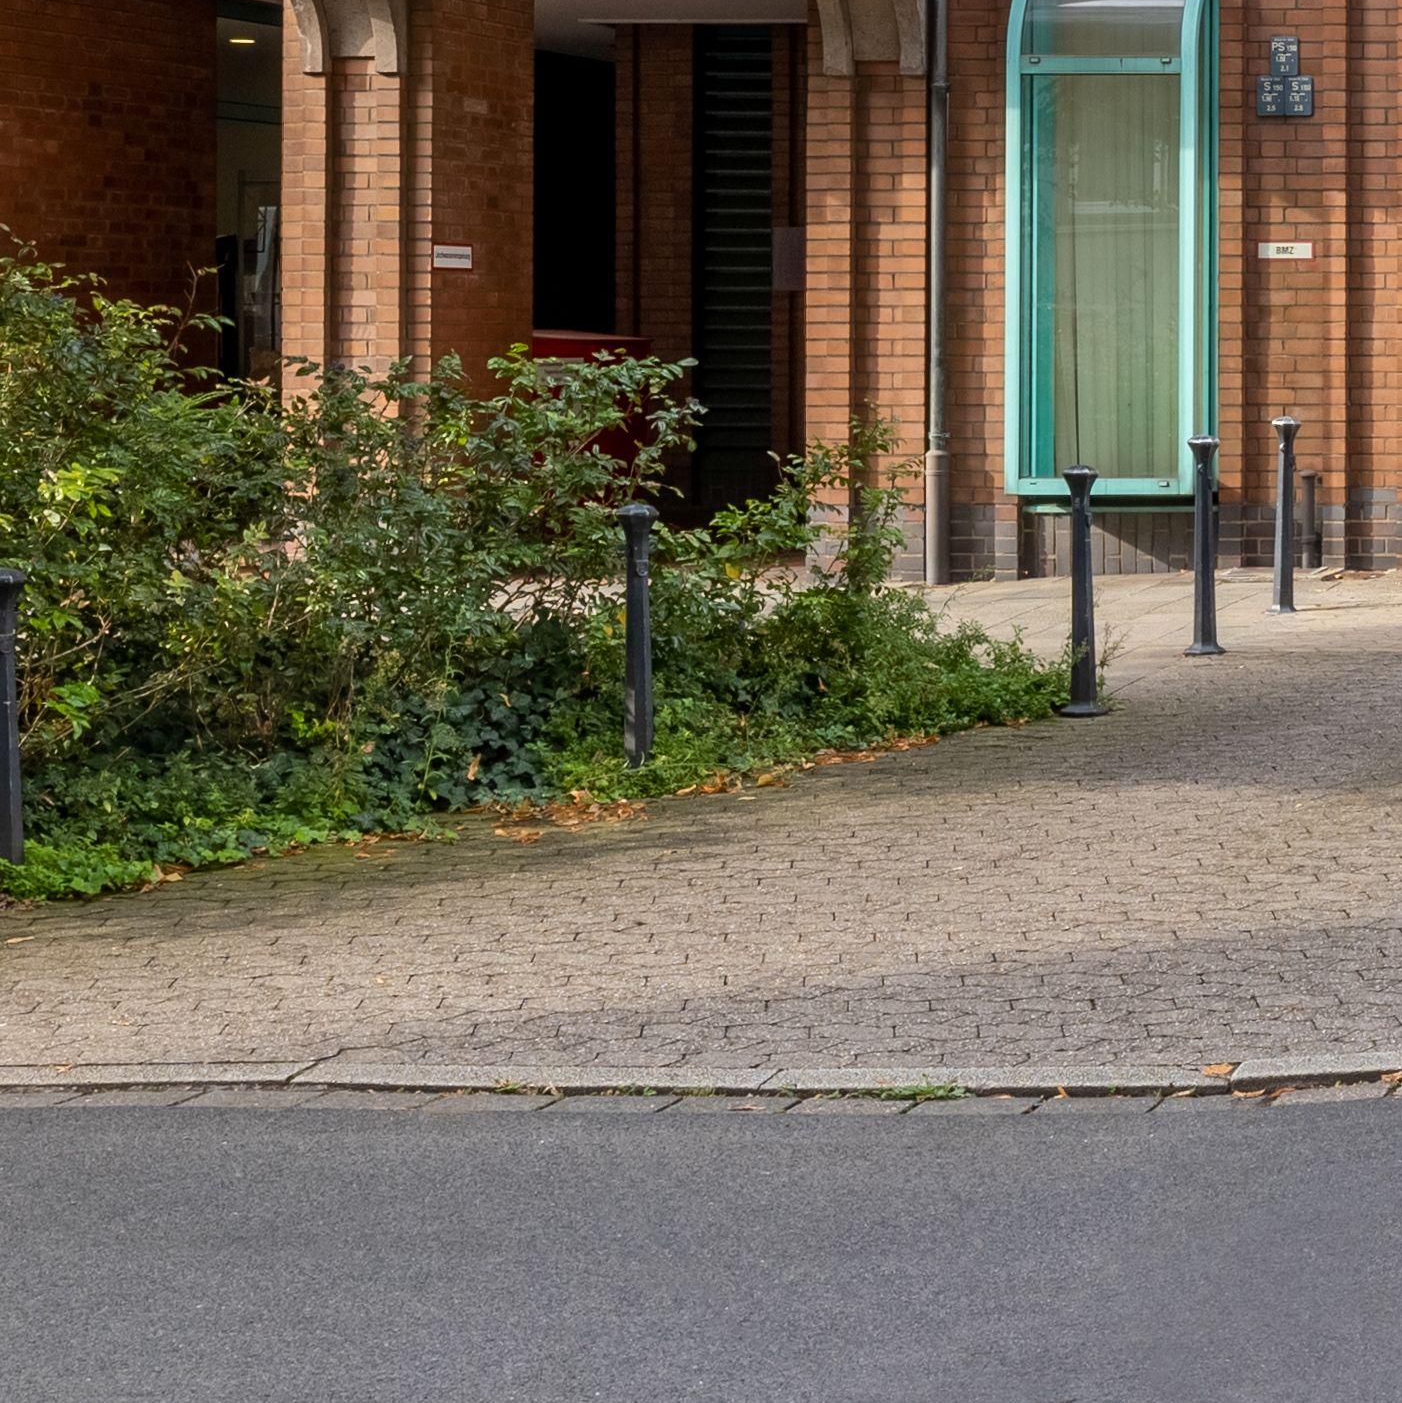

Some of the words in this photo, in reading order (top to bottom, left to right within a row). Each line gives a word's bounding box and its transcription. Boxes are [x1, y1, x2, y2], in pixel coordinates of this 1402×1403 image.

[1271, 42, 1285, 51] PS
[1263, 82, 1271, 91] S
[1291, 82, 1299, 91] S
[1275, 246, 1295, 255] BMZ
